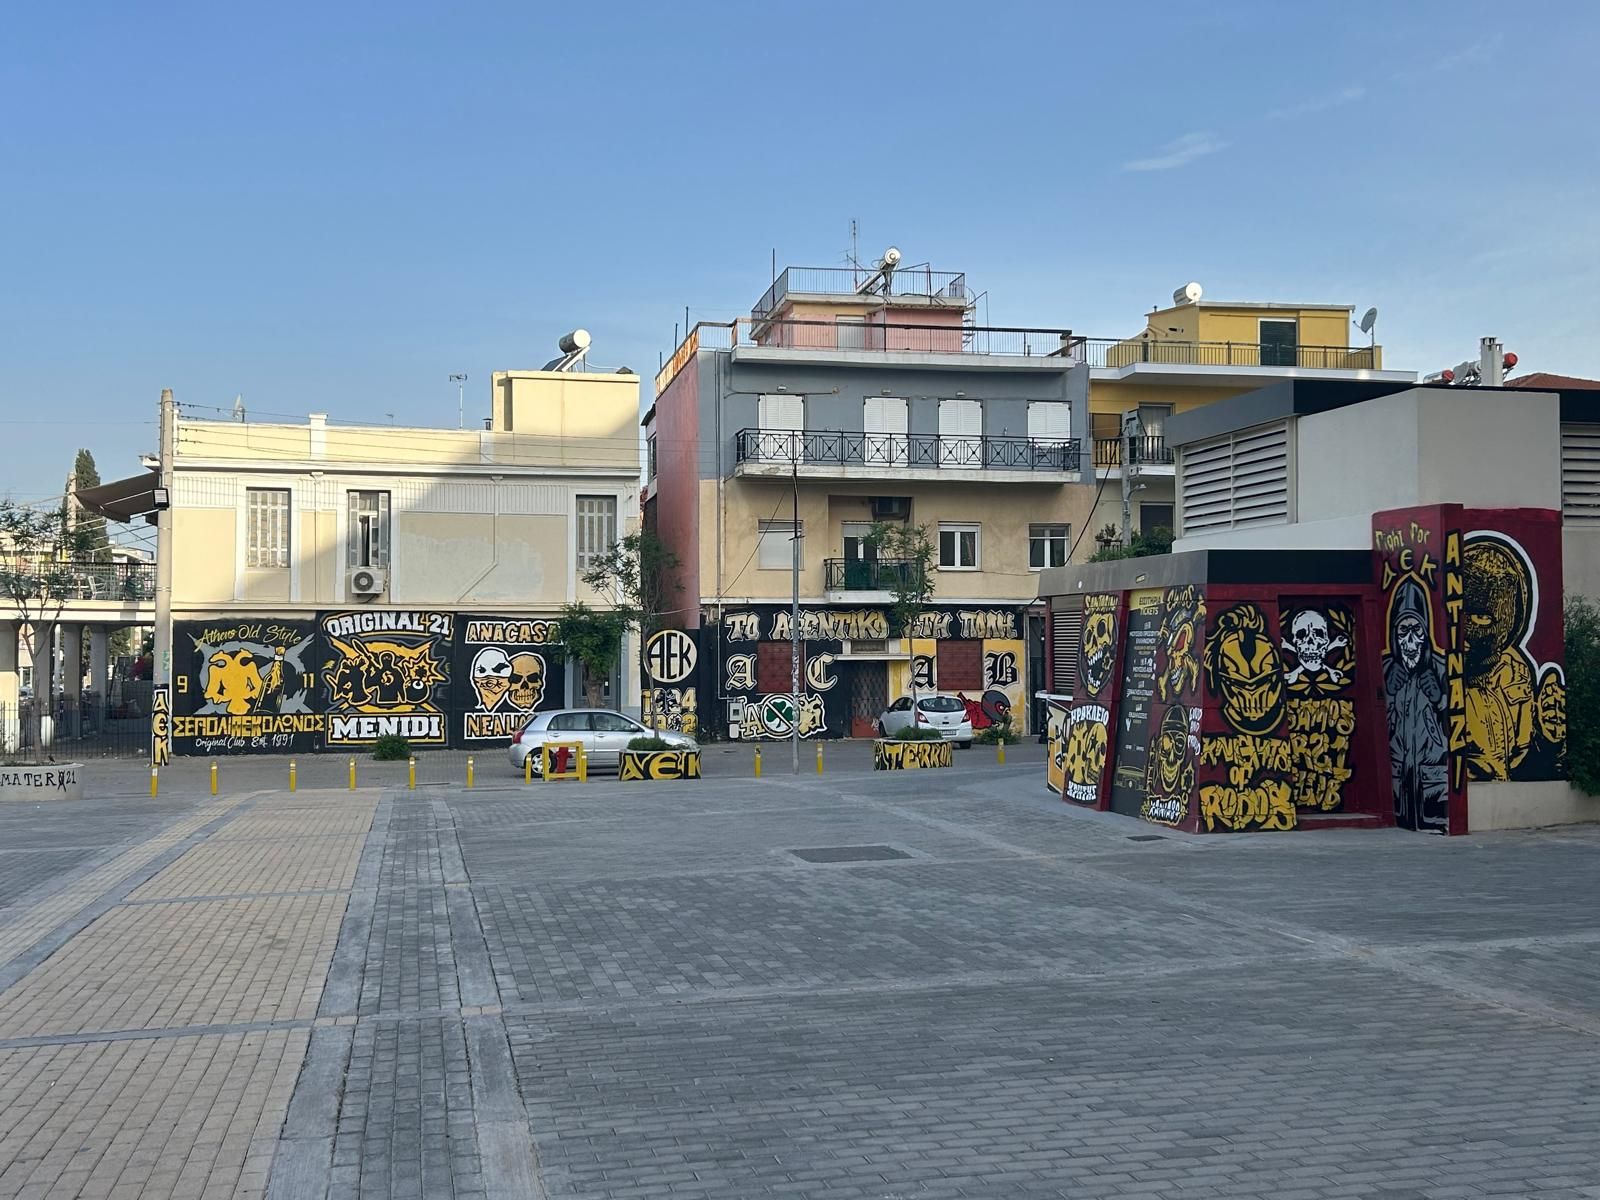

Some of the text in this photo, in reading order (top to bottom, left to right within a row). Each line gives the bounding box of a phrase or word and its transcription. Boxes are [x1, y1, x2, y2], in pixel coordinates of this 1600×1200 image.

[238, 625, 262, 639] Old
[263, 625, 302, 645] Style
[326, 612, 450, 637] ORIGINAL 21
[332, 716, 440, 739] MENIDI
[1200, 780, 1297, 832] RODOS
